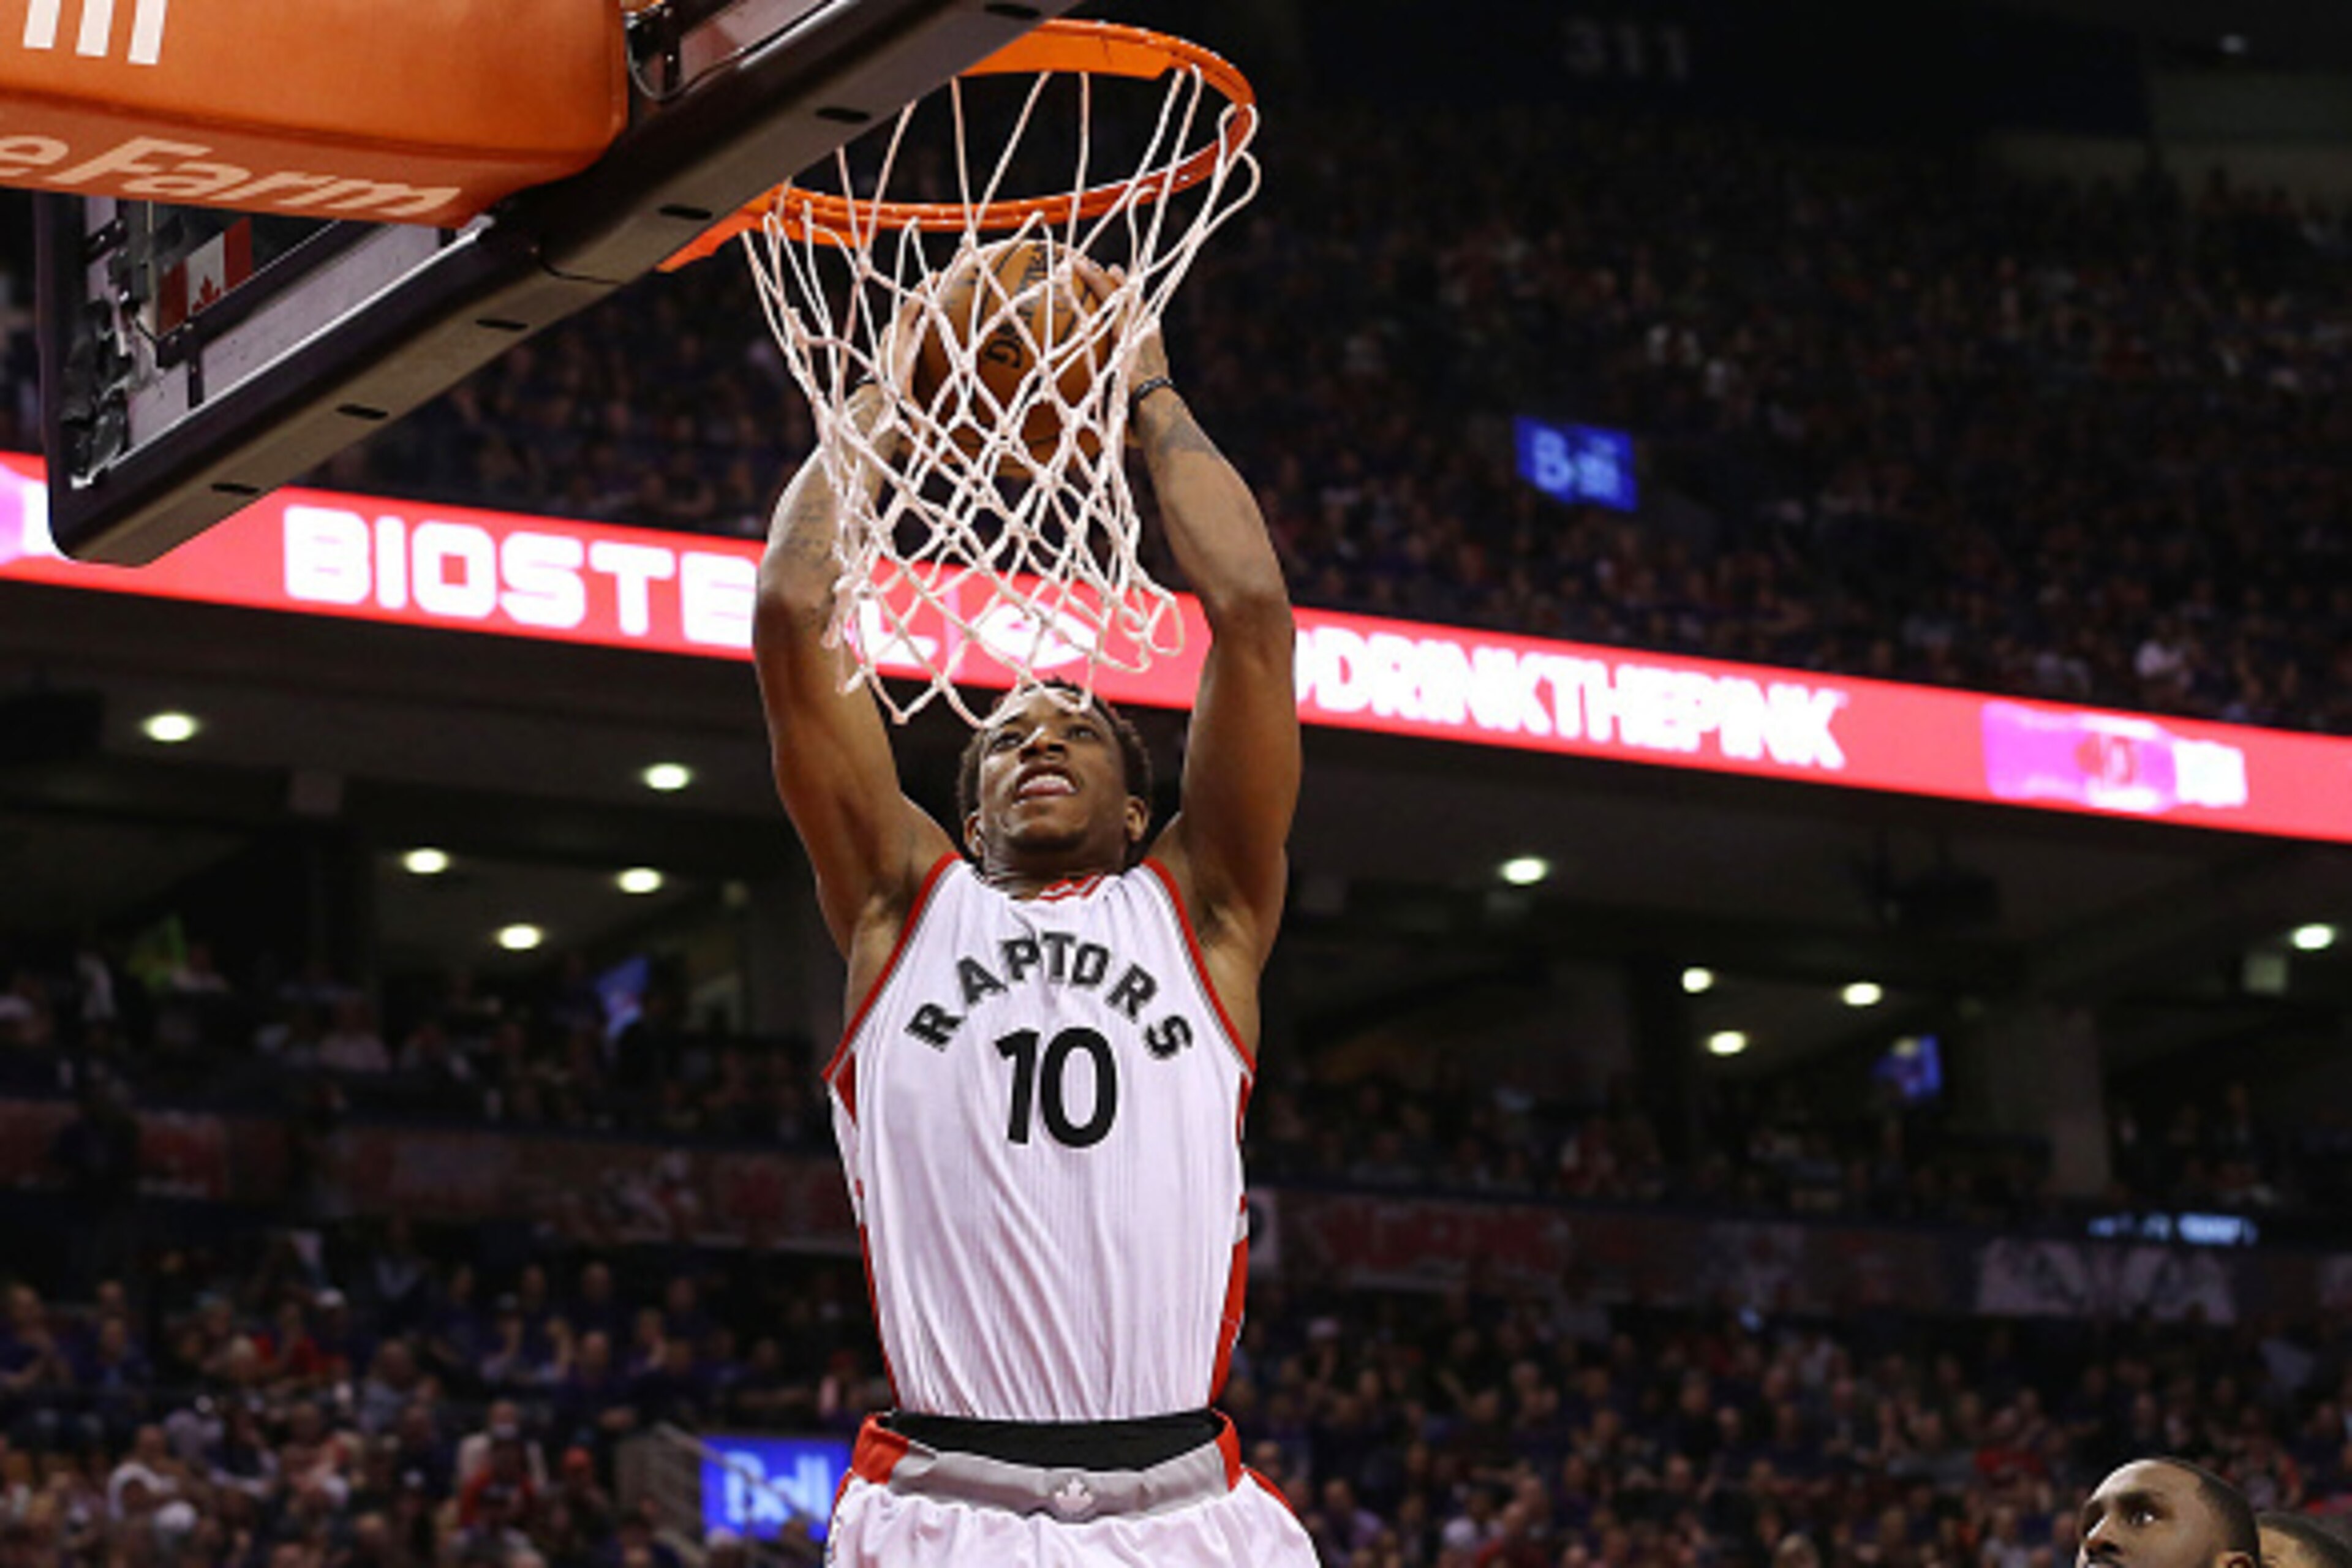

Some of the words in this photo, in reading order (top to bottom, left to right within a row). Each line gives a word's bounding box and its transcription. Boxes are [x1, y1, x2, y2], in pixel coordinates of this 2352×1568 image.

[44, 136, 461, 216] Farm
[283, 504, 940, 669] BIOSTEL
[904, 931, 1194, 1060] RAPTORS
[994, 1027, 1118, 1148] 10
